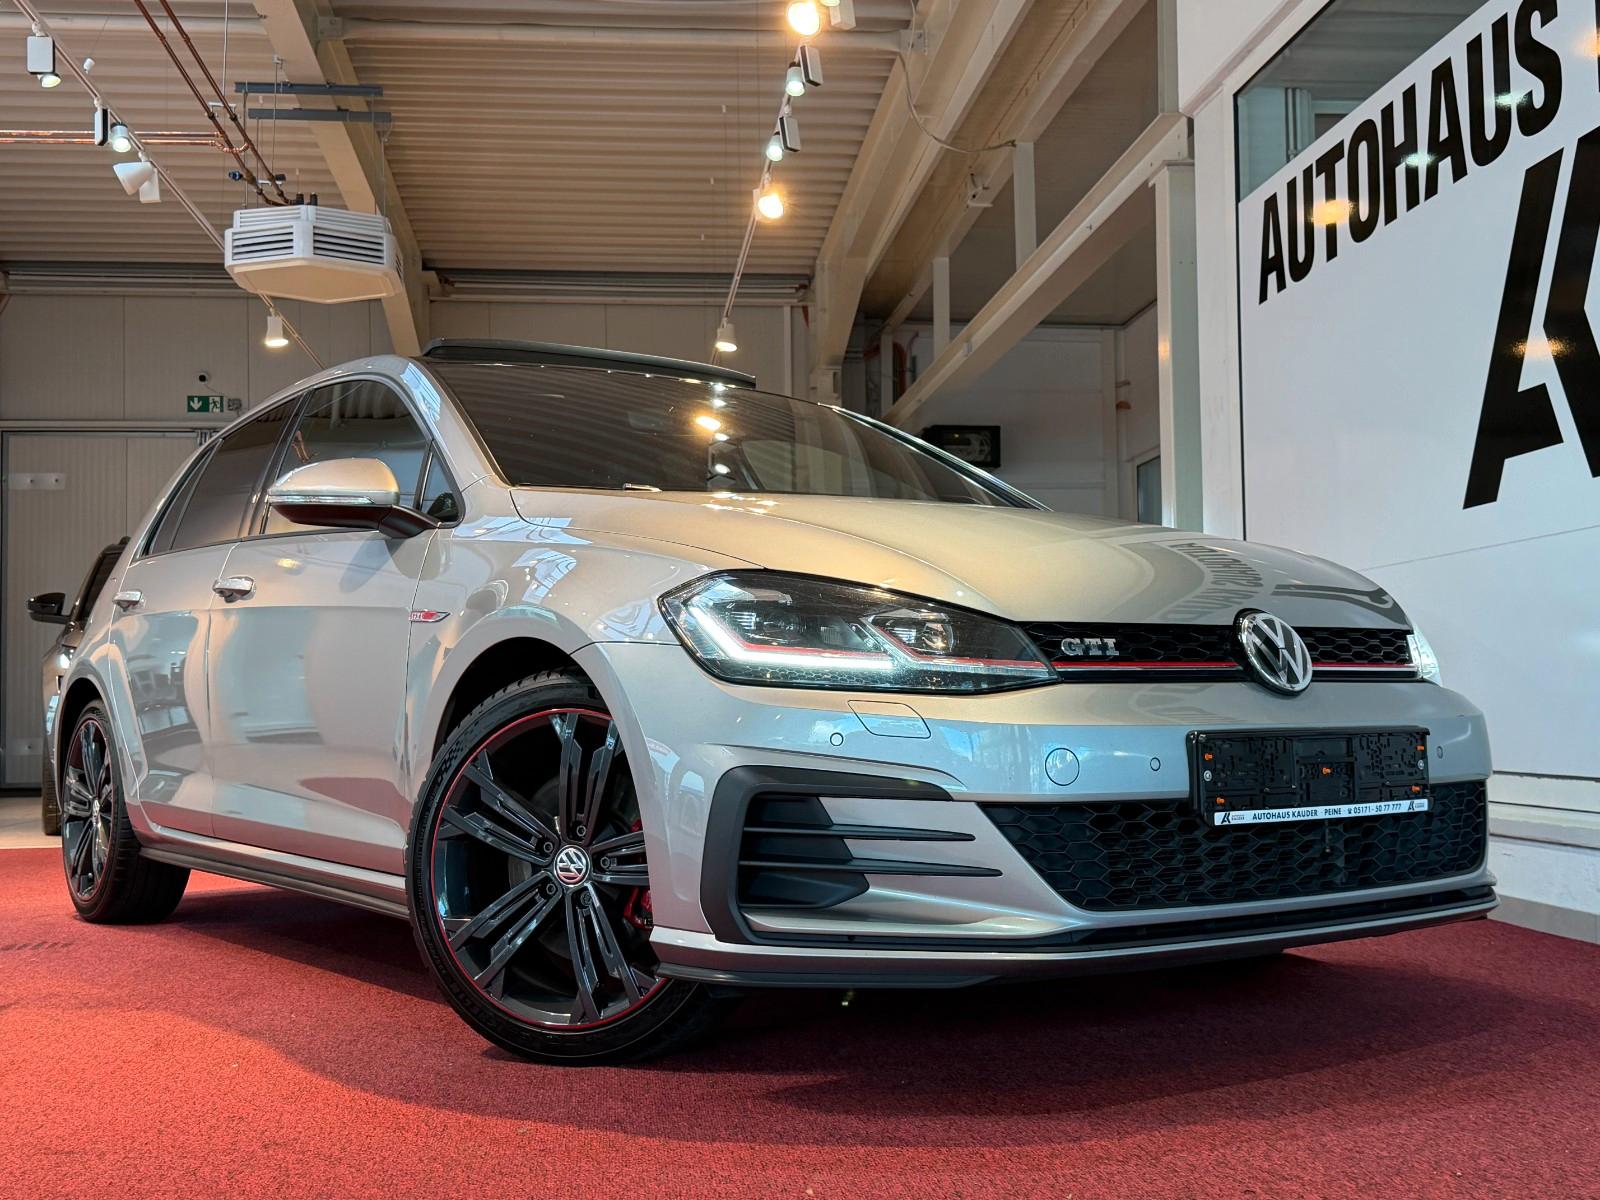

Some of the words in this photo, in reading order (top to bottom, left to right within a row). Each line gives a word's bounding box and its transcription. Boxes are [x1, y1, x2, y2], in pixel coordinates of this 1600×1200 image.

[1259, 0, 1562, 305] AUTOHAUS
[1061, 637, 1120, 656] GTI
[1252, 810, 1290, 821] AUTOHAUS
[1291, 809, 1318, 819] KAUDER
[1324, 807, 1342, 816] PEINE
[1353, 805, 1371, 814] 05171
